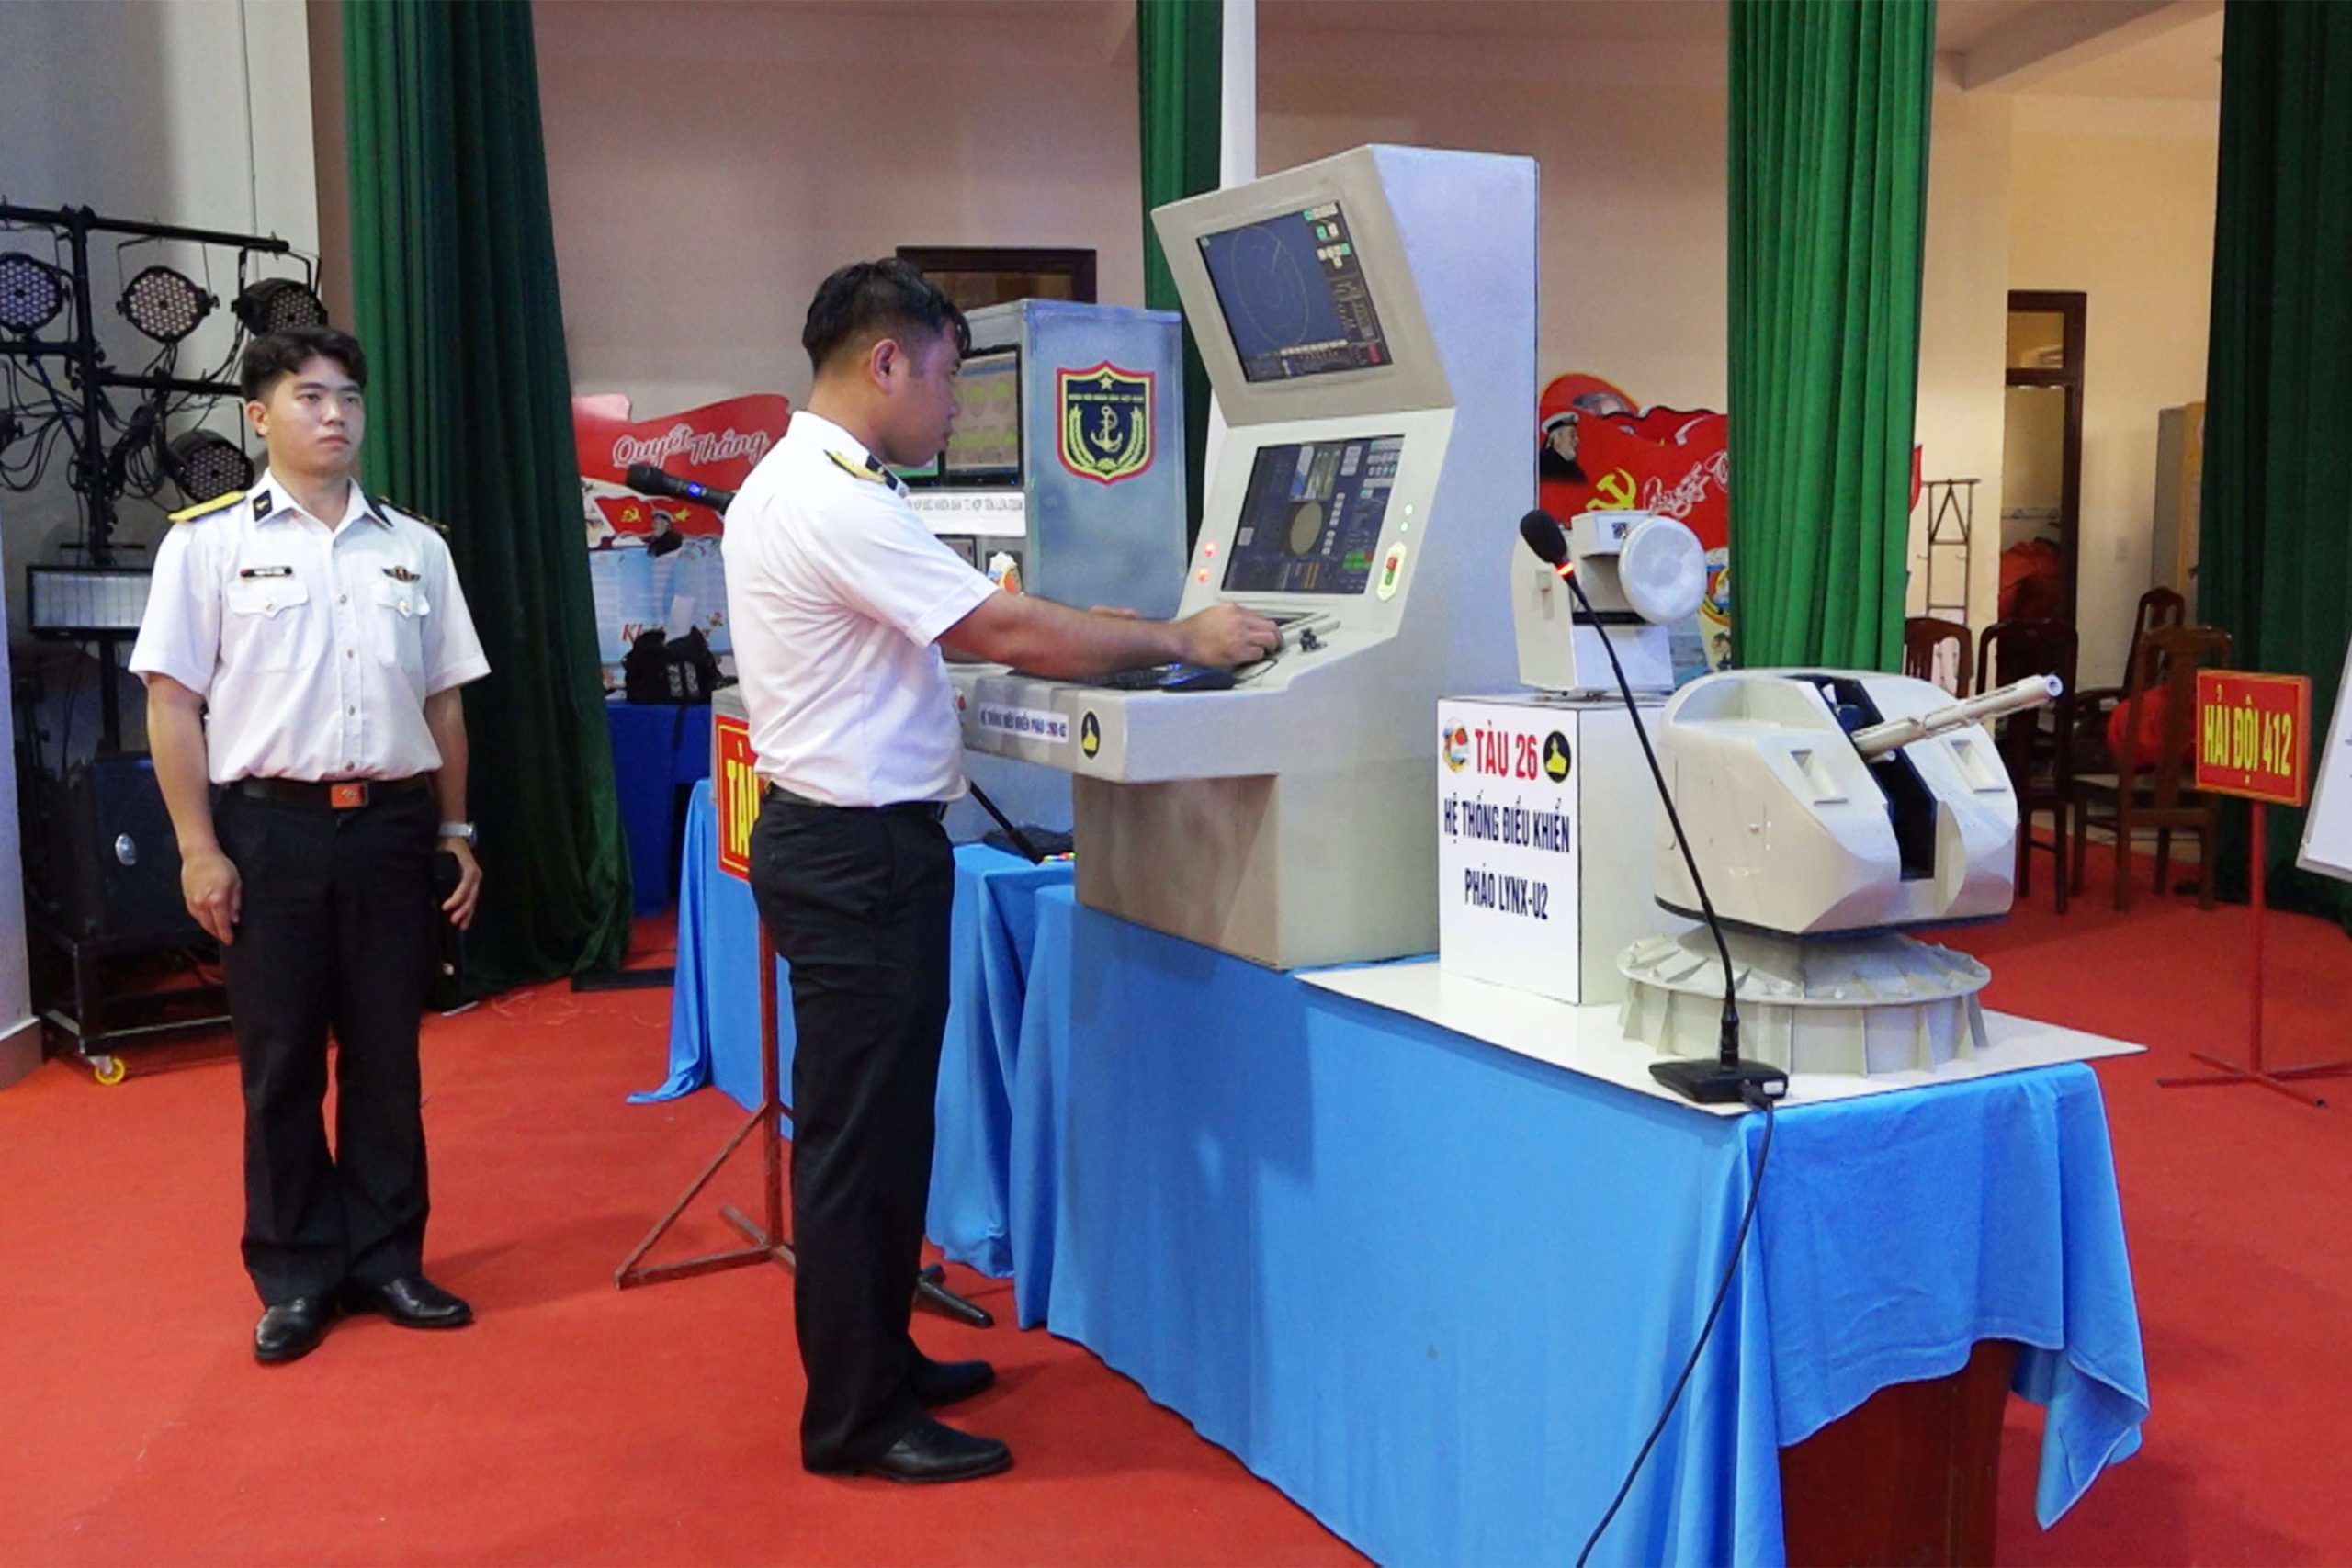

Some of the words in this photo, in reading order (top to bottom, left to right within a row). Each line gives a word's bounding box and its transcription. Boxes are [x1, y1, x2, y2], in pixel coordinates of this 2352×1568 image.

[689, 427, 770, 466] Thắng
[1475, 720, 1509, 778] TÀU
[1515, 733, 1538, 781] 26
[2205, 682, 2230, 766] HẢI
[2233, 694, 2259, 784] ĐỘI
[2263, 710, 2291, 777] 412
[1443, 792, 1459, 844] HỆ
[1462, 789, 1499, 842] THỐNG
[1464, 863, 1495, 909] PHÁO
[1498, 875, 1548, 920] LYNX-U2
